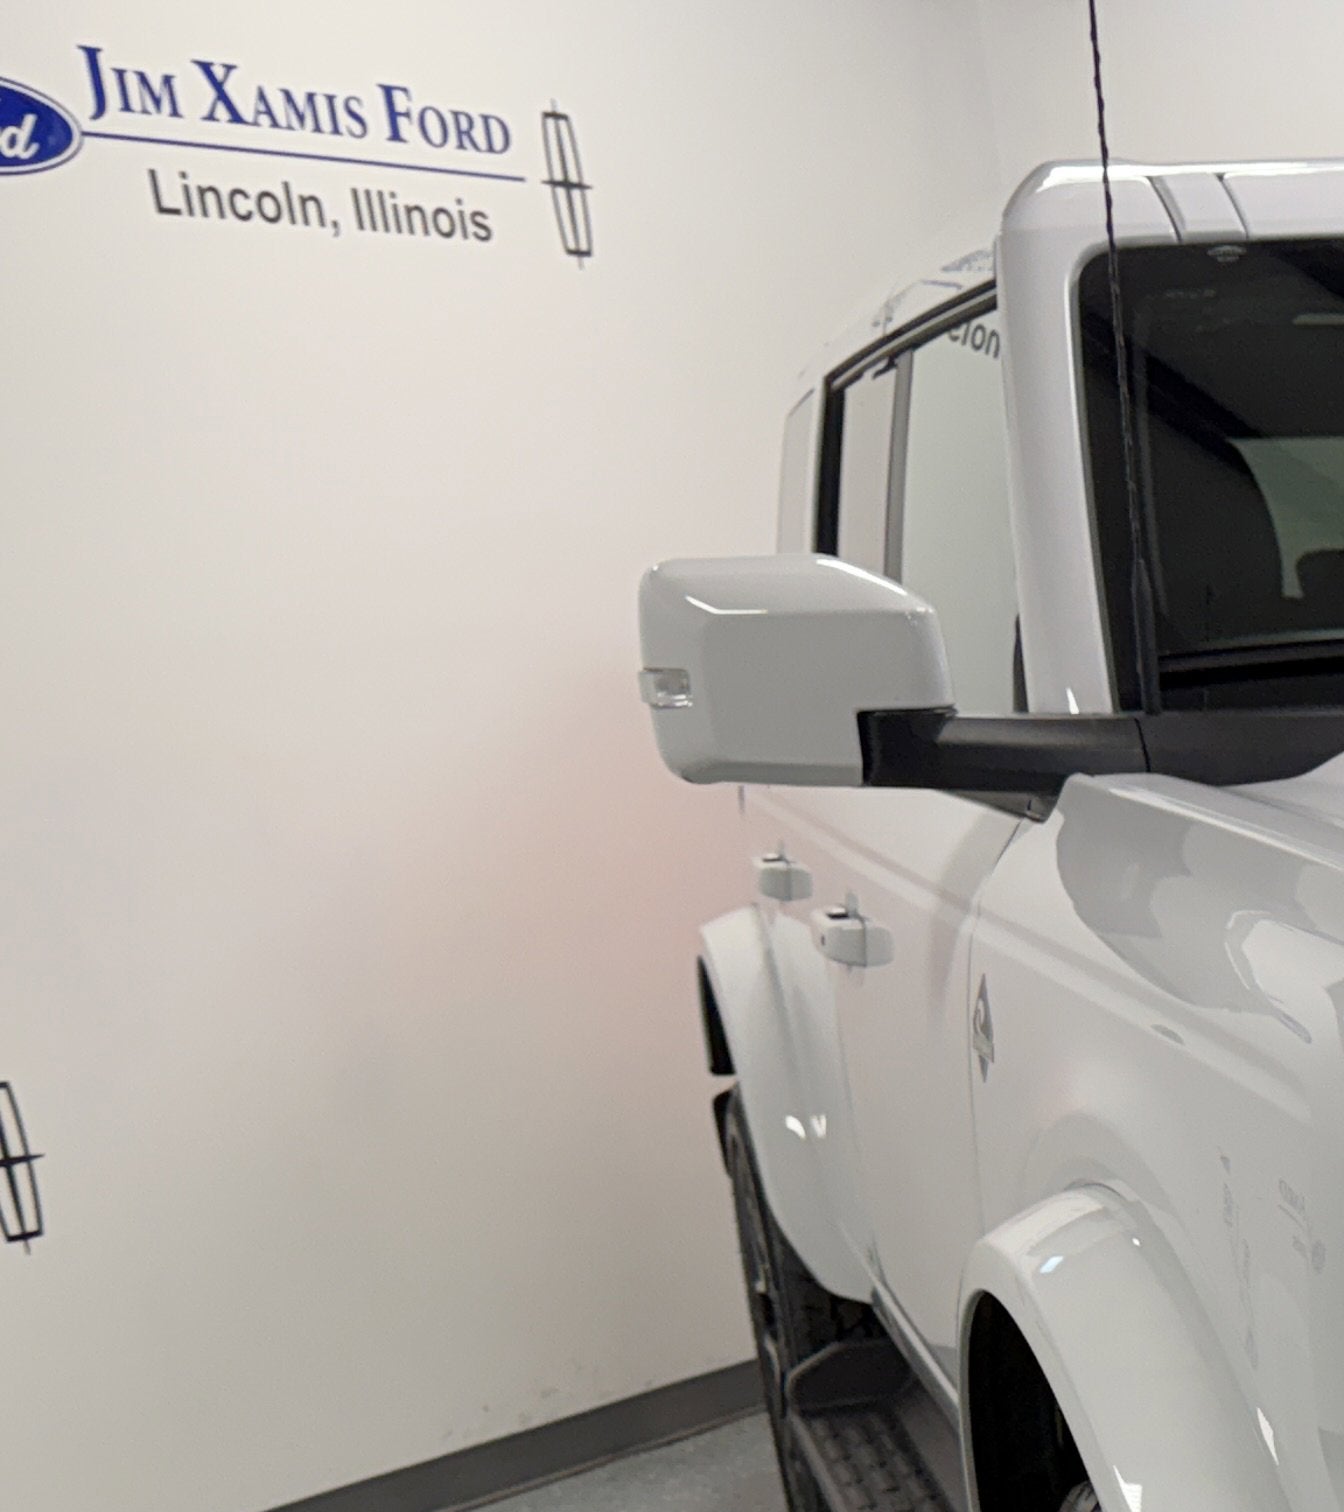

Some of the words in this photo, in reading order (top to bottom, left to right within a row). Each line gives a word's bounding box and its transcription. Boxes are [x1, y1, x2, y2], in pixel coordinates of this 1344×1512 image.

[377, 83, 512, 155] FORD
[148, 168, 340, 238] Lincoln,
[350, 187, 493, 243] Illinois
